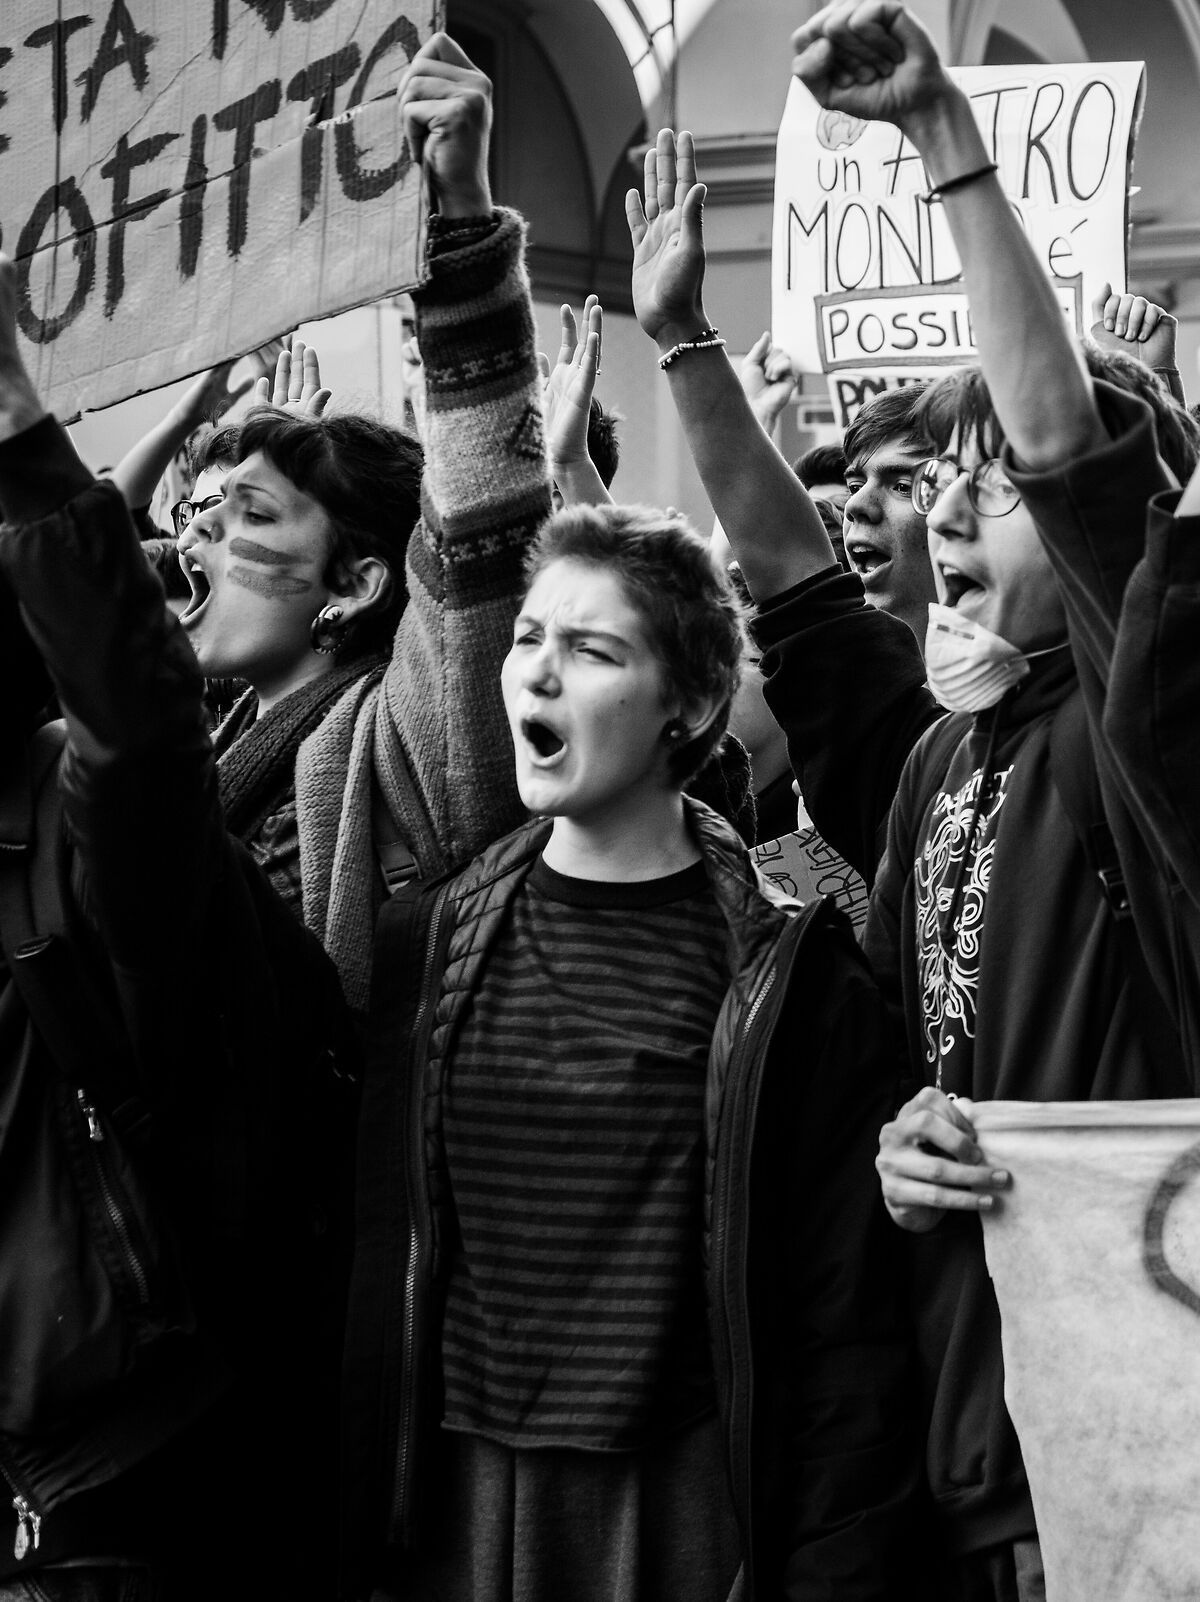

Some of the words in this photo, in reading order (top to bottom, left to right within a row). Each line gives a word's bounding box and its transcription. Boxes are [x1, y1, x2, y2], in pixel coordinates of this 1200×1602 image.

[0, 14, 424, 345] OFITTO
[817, 156, 861, 192] un
[883, 80, 1116, 204] ATRO
[787, 194, 1025, 293] MOND
[828, 308, 976, 359] POSSI
